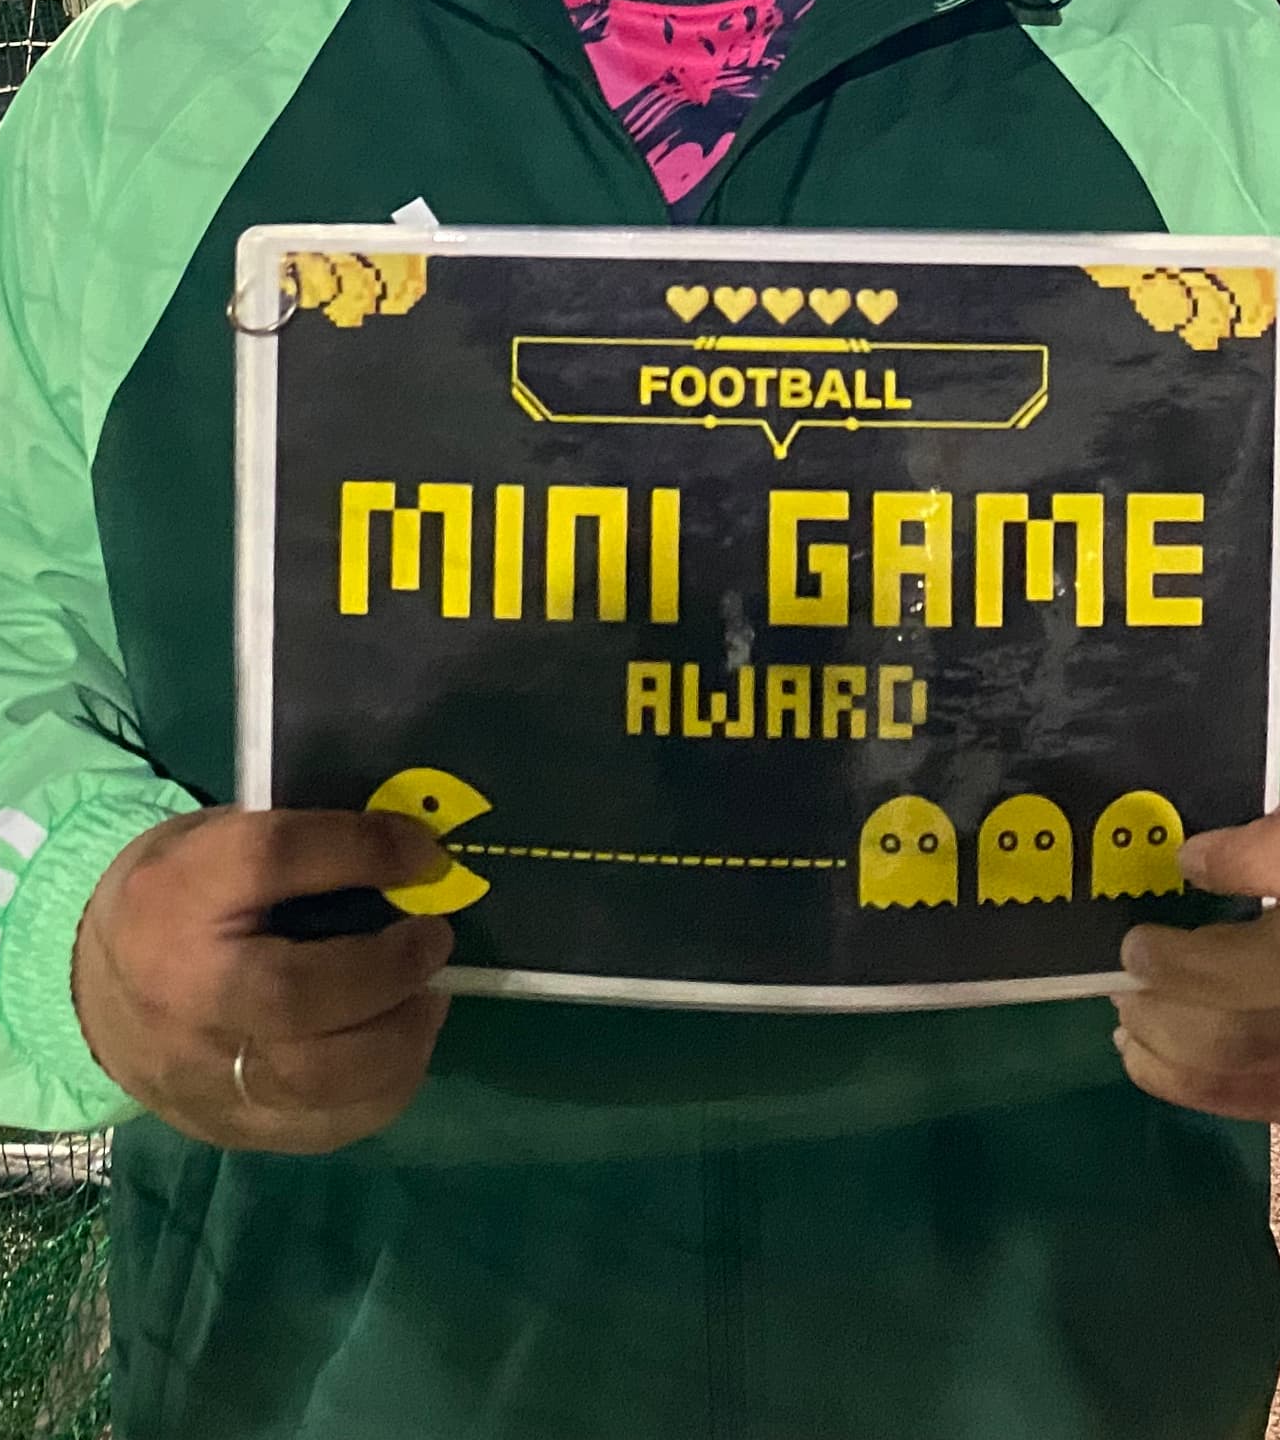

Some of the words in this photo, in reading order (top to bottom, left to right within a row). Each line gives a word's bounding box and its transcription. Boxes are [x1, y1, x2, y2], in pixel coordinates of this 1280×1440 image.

[639, 365, 913, 411] FOOTBALL
[339, 481, 681, 623] MINI
[767, 489, 1205, 628] GAME
[626, 661, 928, 740] AWARD
